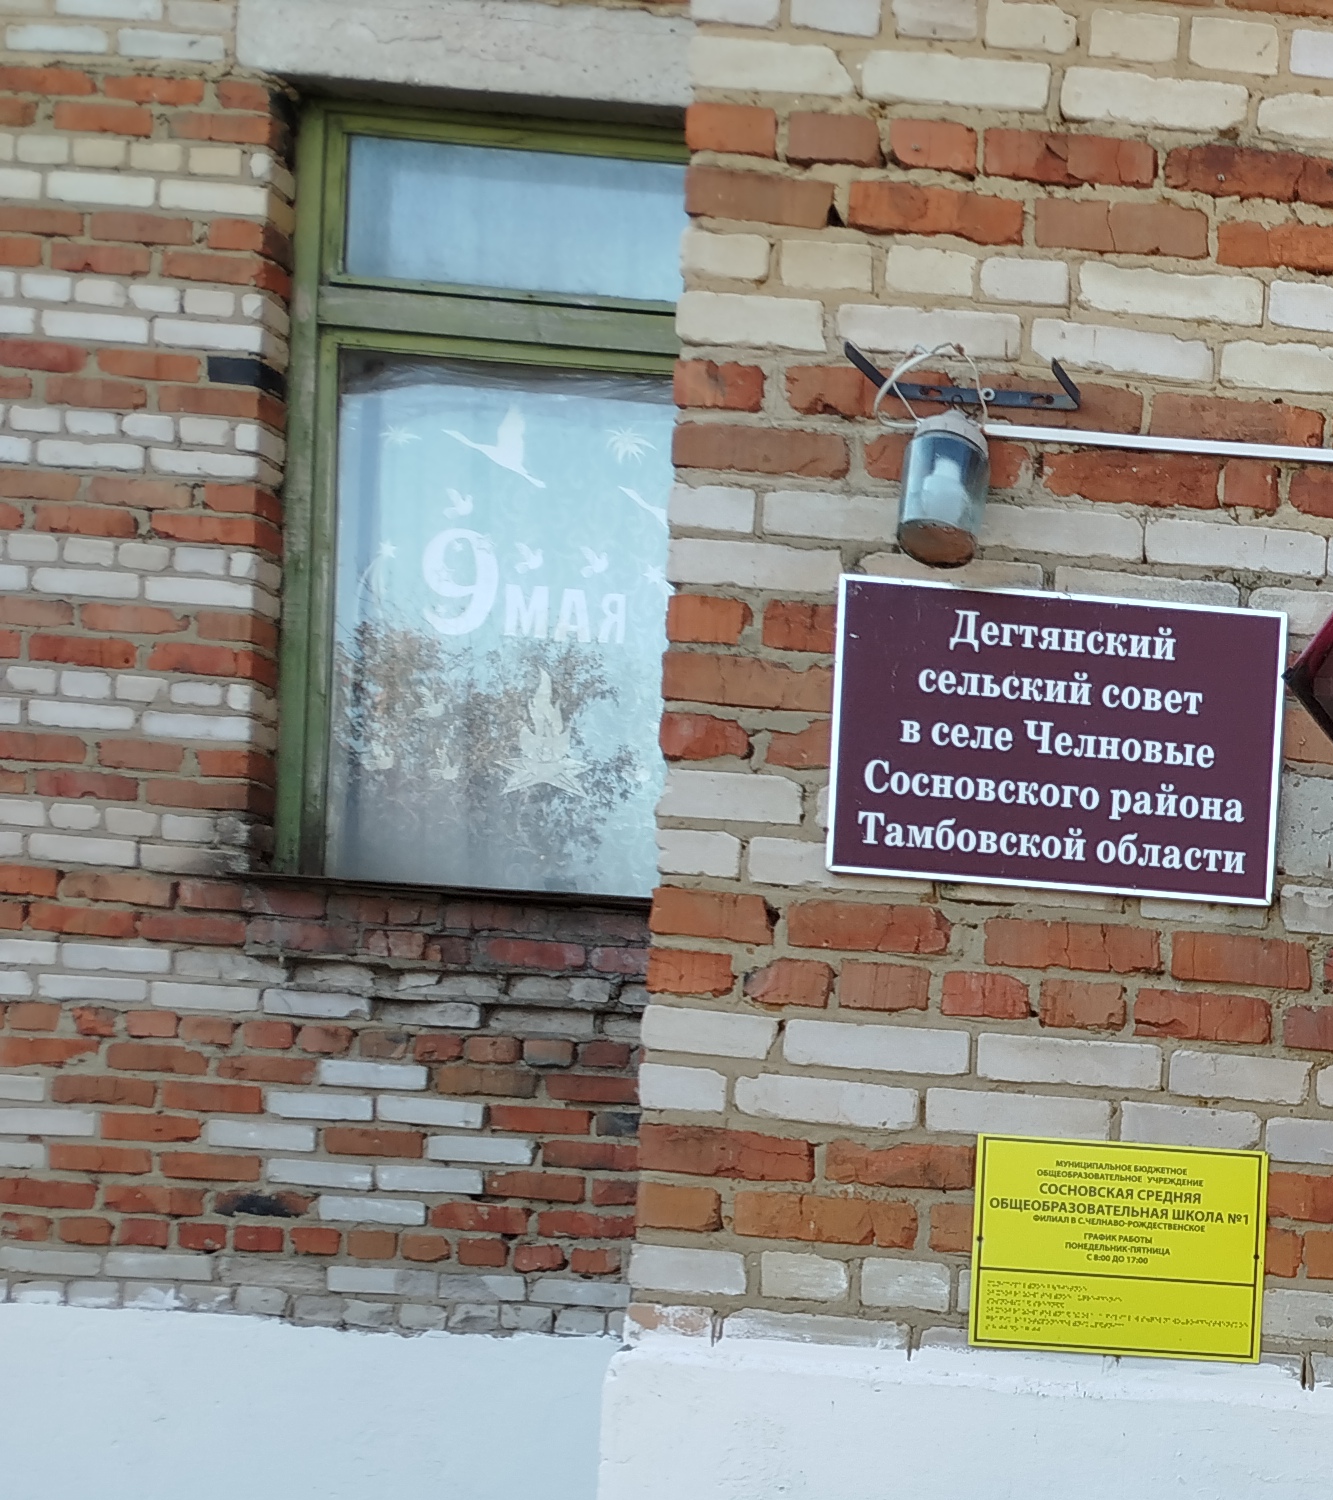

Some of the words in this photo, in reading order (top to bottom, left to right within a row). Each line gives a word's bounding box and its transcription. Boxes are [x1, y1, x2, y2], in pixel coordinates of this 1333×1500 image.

[422, 528, 499, 636] 9
[503, 583, 626, 645] МАЯ
[949, 609, 1176, 661] Дегтянский
[918, 667, 1092, 706] сельский
[1102, 685, 1203, 716] совет
[900, 719, 921, 743] в
[931, 722, 1013, 752] селе
[1024, 721, 1215, 768] Челновые
[864, 759, 1100, 810] Сосновского
[1109, 784, 1244, 823] района
[858, 810, 1085, 861] Тамбовской
[1096, 833, 1246, 875] области
[1037, 1169, 1142, 1182] ОБЩЕОБРАЗОВАТЕЛЬНОЕ
[1147, 1176, 1204, 1187] УЧРЕЖДЕНИЕ
[1056, 1160, 1132, 1172] МУНИЦИПАЛЬНОЕ
[1134, 1165, 1187, 1175] БЮДЖЕТНОЕ
[1039, 1183, 1134, 1199] СОСНОВСКАЯ
[1137, 1189, 1201, 1205] СРЕДНЯЯ
[989, 1197, 1168, 1219] ОБЩЕОБРАЗОВАТЕЛЬНАЯ
[1172, 1209, 1224, 1223] ШКОЛА
[1227, 1213, 1249, 1225] №1
[1033, 1214, 1069, 1223] ФИЛИАЛ
[1065, 1242, 1170, 1256] ПОНЕДЕЛЬНИК-ПЯТНИЦА
[1083, 1232, 1117, 1242] ГРАФИК
[1118, 1235, 1152, 1244] РАБОТЫ
[1112, 1255, 1124, 1263] ДО
